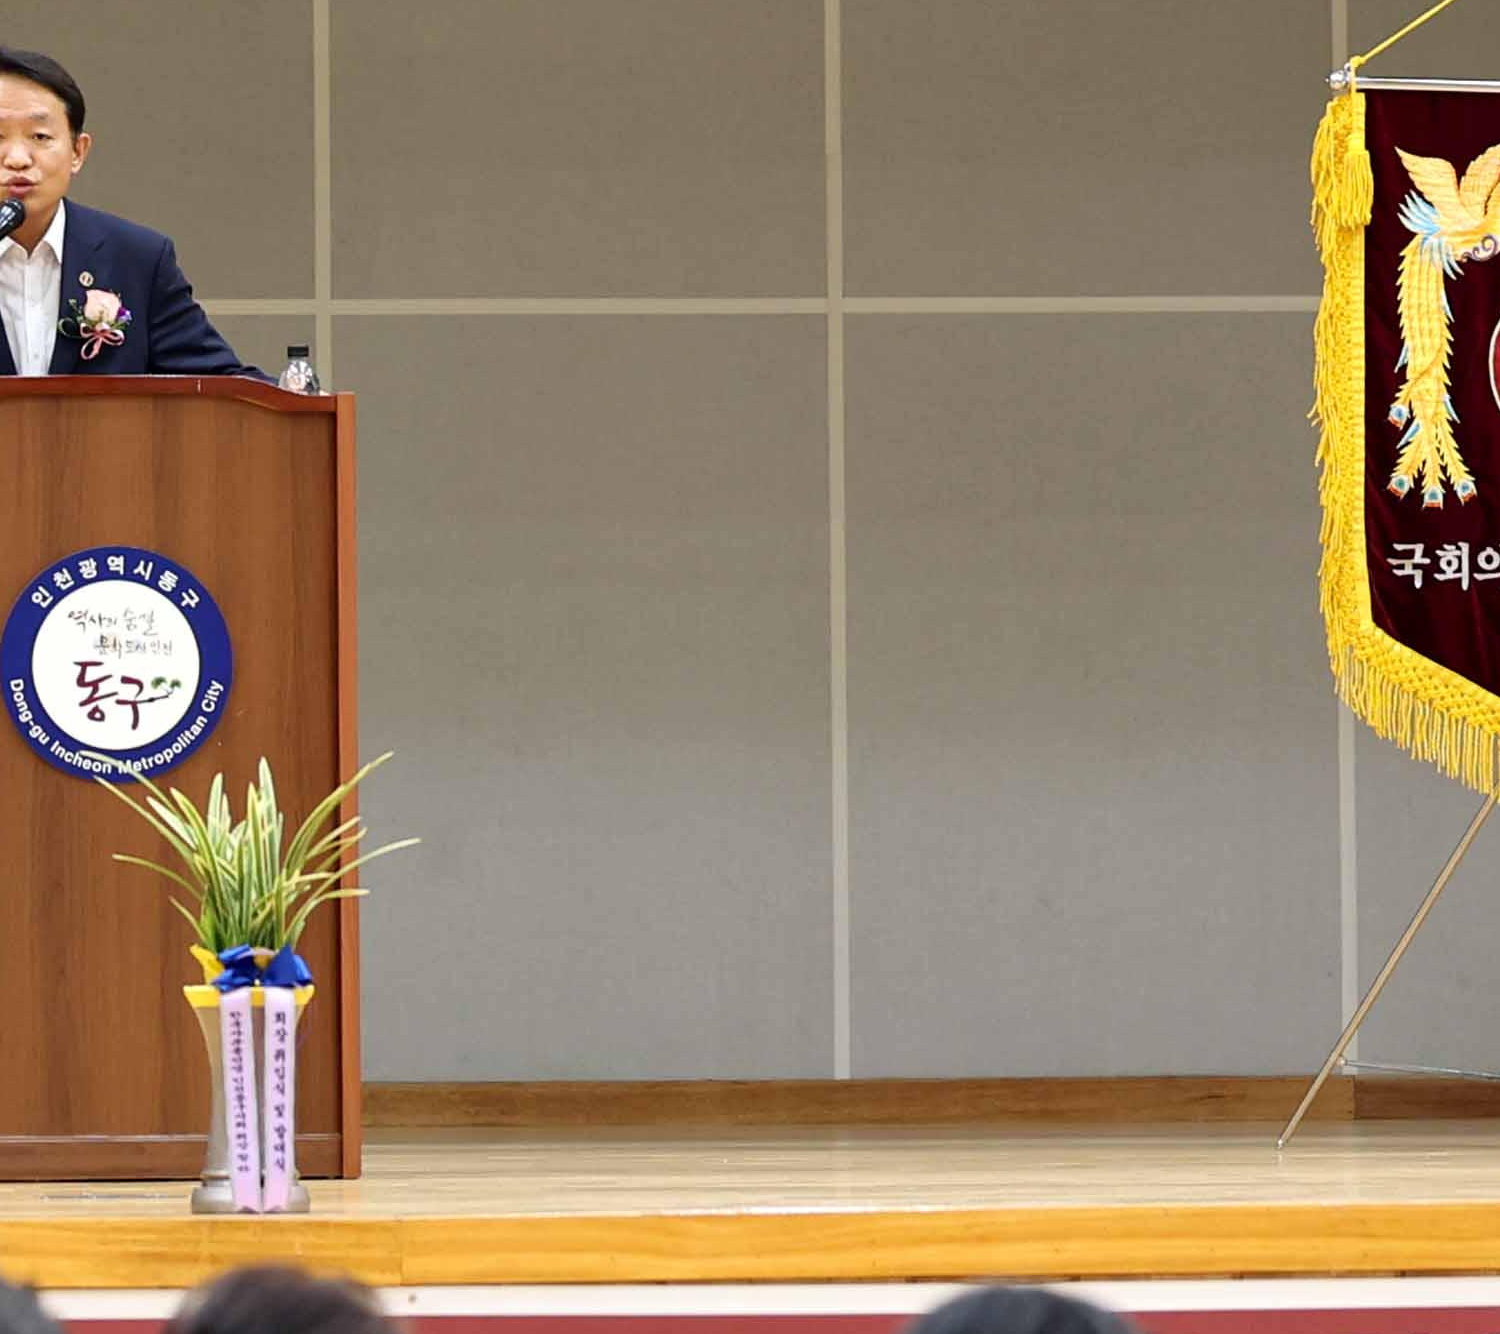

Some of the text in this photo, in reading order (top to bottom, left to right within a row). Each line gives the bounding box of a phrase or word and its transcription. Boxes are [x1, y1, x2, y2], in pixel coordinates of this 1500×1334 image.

[9, 678, 224, 775] Dong-gu Incheon Metropolitan City
[73, 660, 147, 731] 동구
